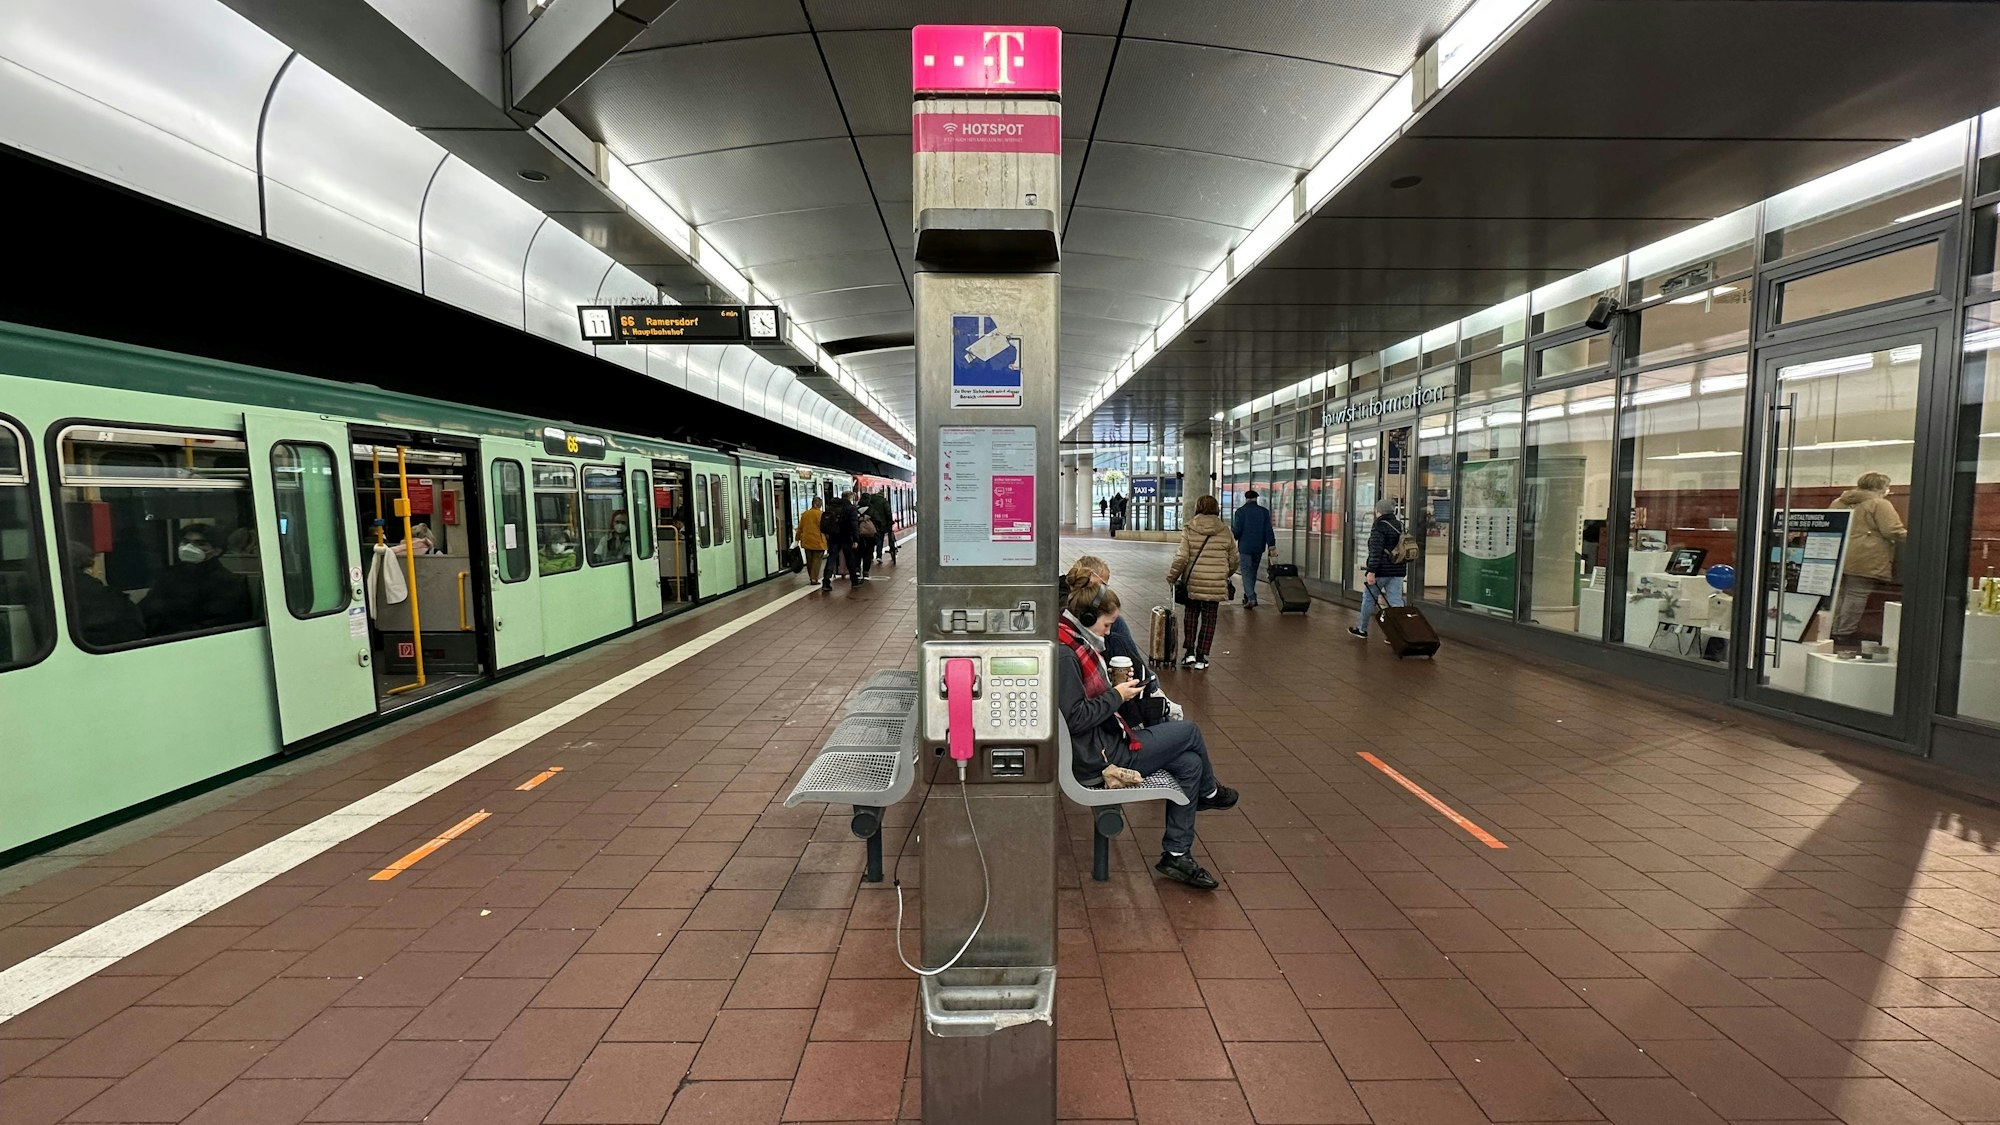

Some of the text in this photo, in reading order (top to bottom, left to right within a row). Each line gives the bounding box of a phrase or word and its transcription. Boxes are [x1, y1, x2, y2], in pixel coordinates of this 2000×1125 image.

[983, 32, 1024, 84] T
[962, 123, 1024, 135] HOTSPOT
[592, 320, 606, 334] 11
[620, 316, 699, 327] 66 Ramersdorf
[632, 328, 685, 336] Hauptbahnhof
[1322, 386, 1444, 427] tourist information
[567, 435, 579, 453] 66
[1134, 486, 1148, 494] TAXI
